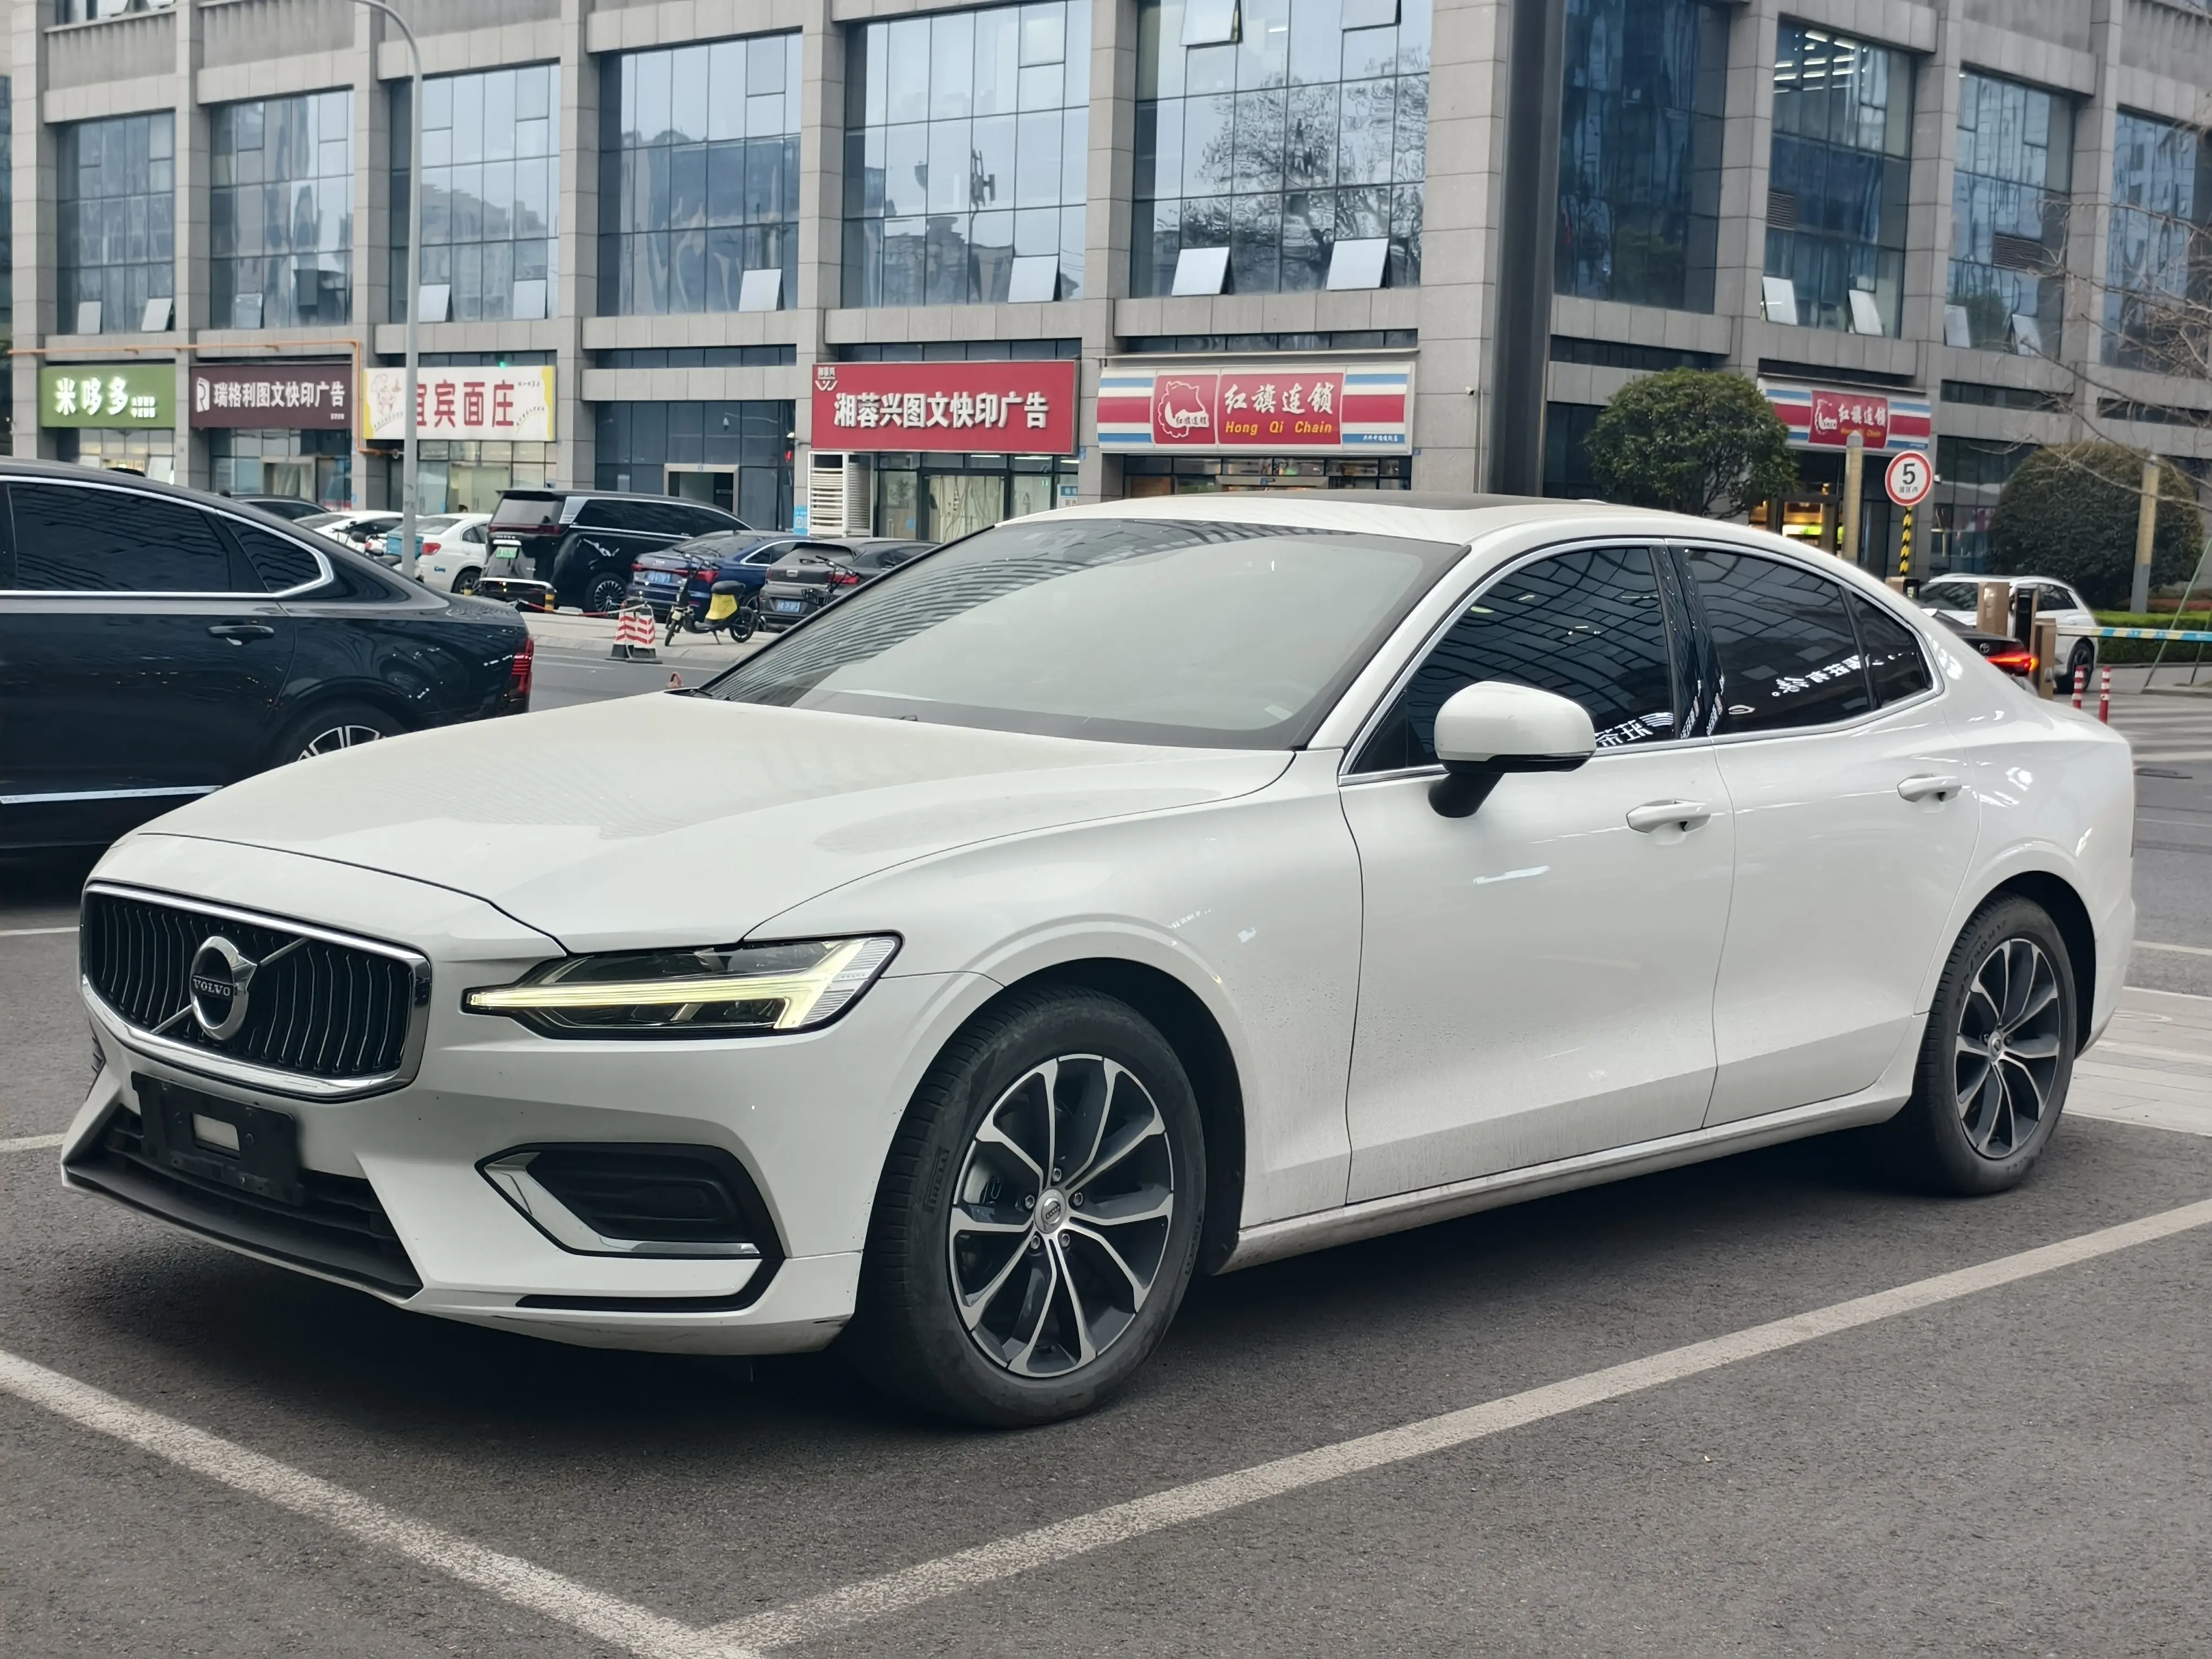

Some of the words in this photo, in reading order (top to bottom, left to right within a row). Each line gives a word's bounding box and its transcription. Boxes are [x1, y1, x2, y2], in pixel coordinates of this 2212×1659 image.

[214, 380, 345, 408] 瑞格利图文快印广告
[1224, 382, 1335, 415] 红旗连锁
[834, 391, 1049, 429] 湘蓉兴图文快印广告
[1838, 404, 1886, 427] 红旗连锁
[1225, 421, 1258, 435] Hong
[1269, 421, 1284, 434] Qi
[1294, 421, 1332, 434] Chain
[1903, 463, 1916, 485] 5
[193, 979, 231, 996] VOLVO
